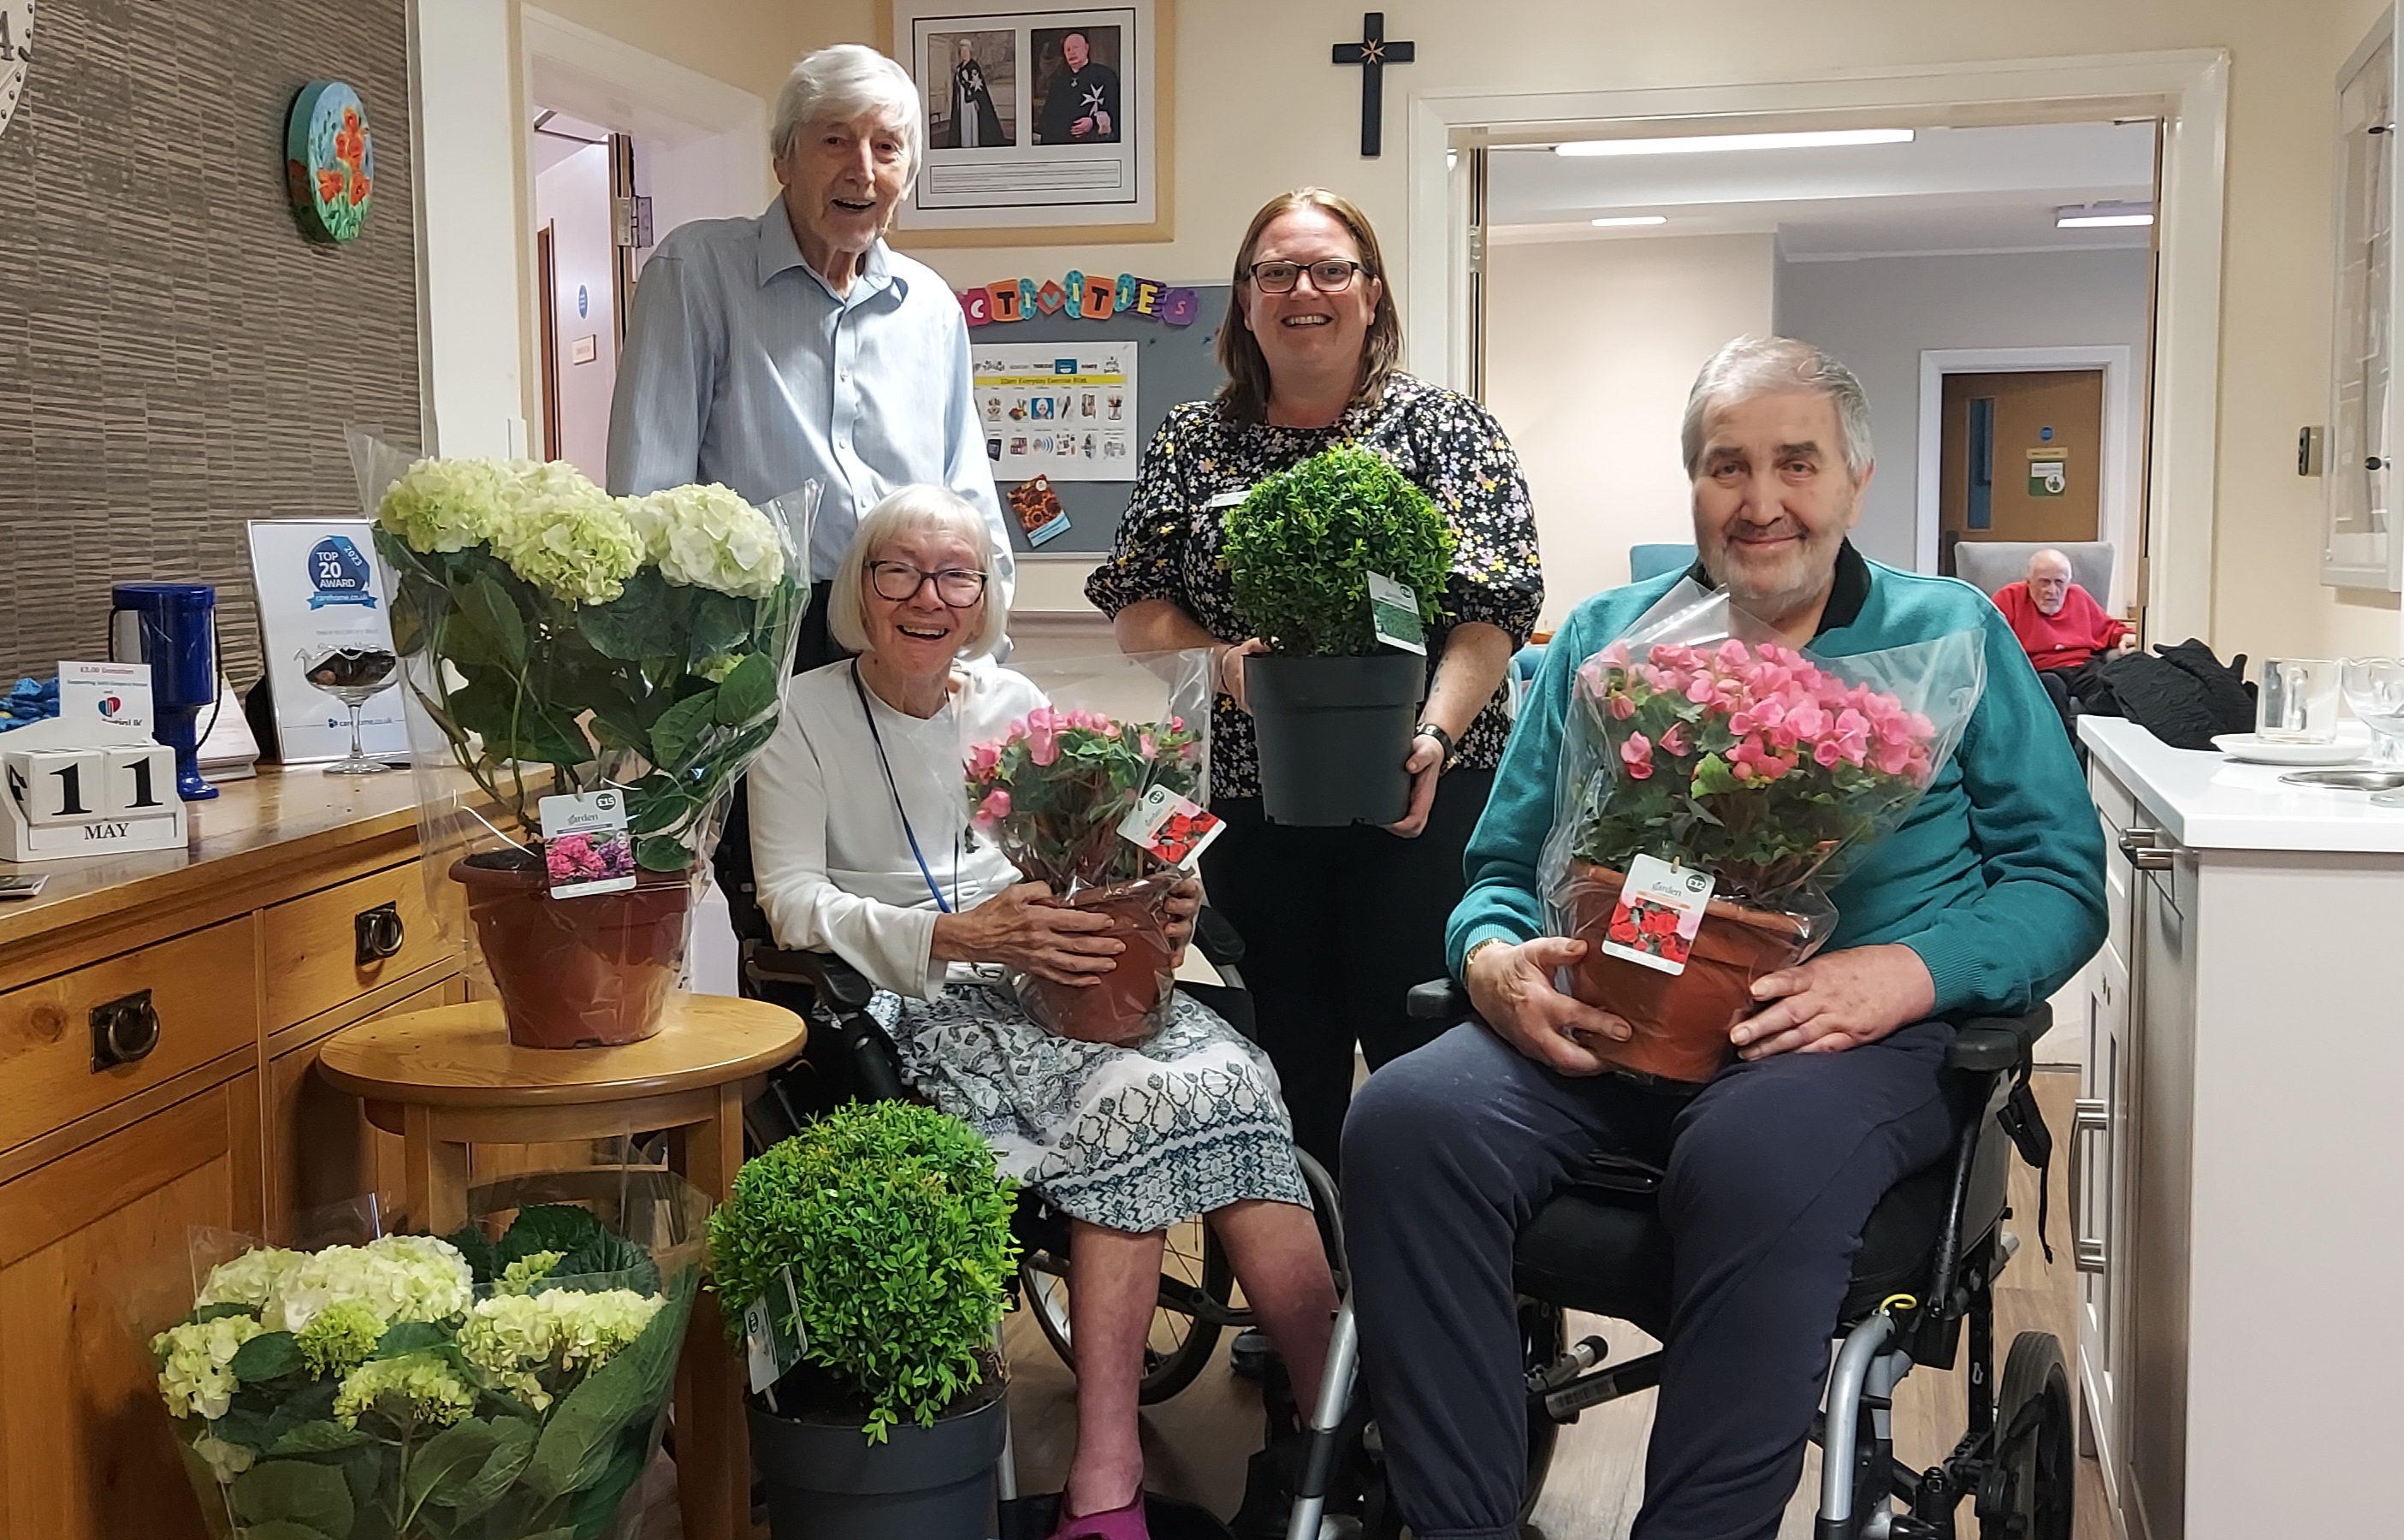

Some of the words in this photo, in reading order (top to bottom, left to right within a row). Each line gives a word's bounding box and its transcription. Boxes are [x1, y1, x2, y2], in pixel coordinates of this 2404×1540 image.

[969, 281, 1188, 321] CTIVITIES
[316, 551, 339, 561] TOP
[344, 545, 363, 566] 2023
[318, 561, 342, 578] 20
[319, 578, 356, 589] AWARD
[50, 762, 93, 816] 1
[121, 755, 164, 808] 1
[596, 797, 615, 807] £15
[84, 822, 130, 840] MAY
[1651, 881, 1683, 897] garden
[1687, 878, 1707, 891] £12
